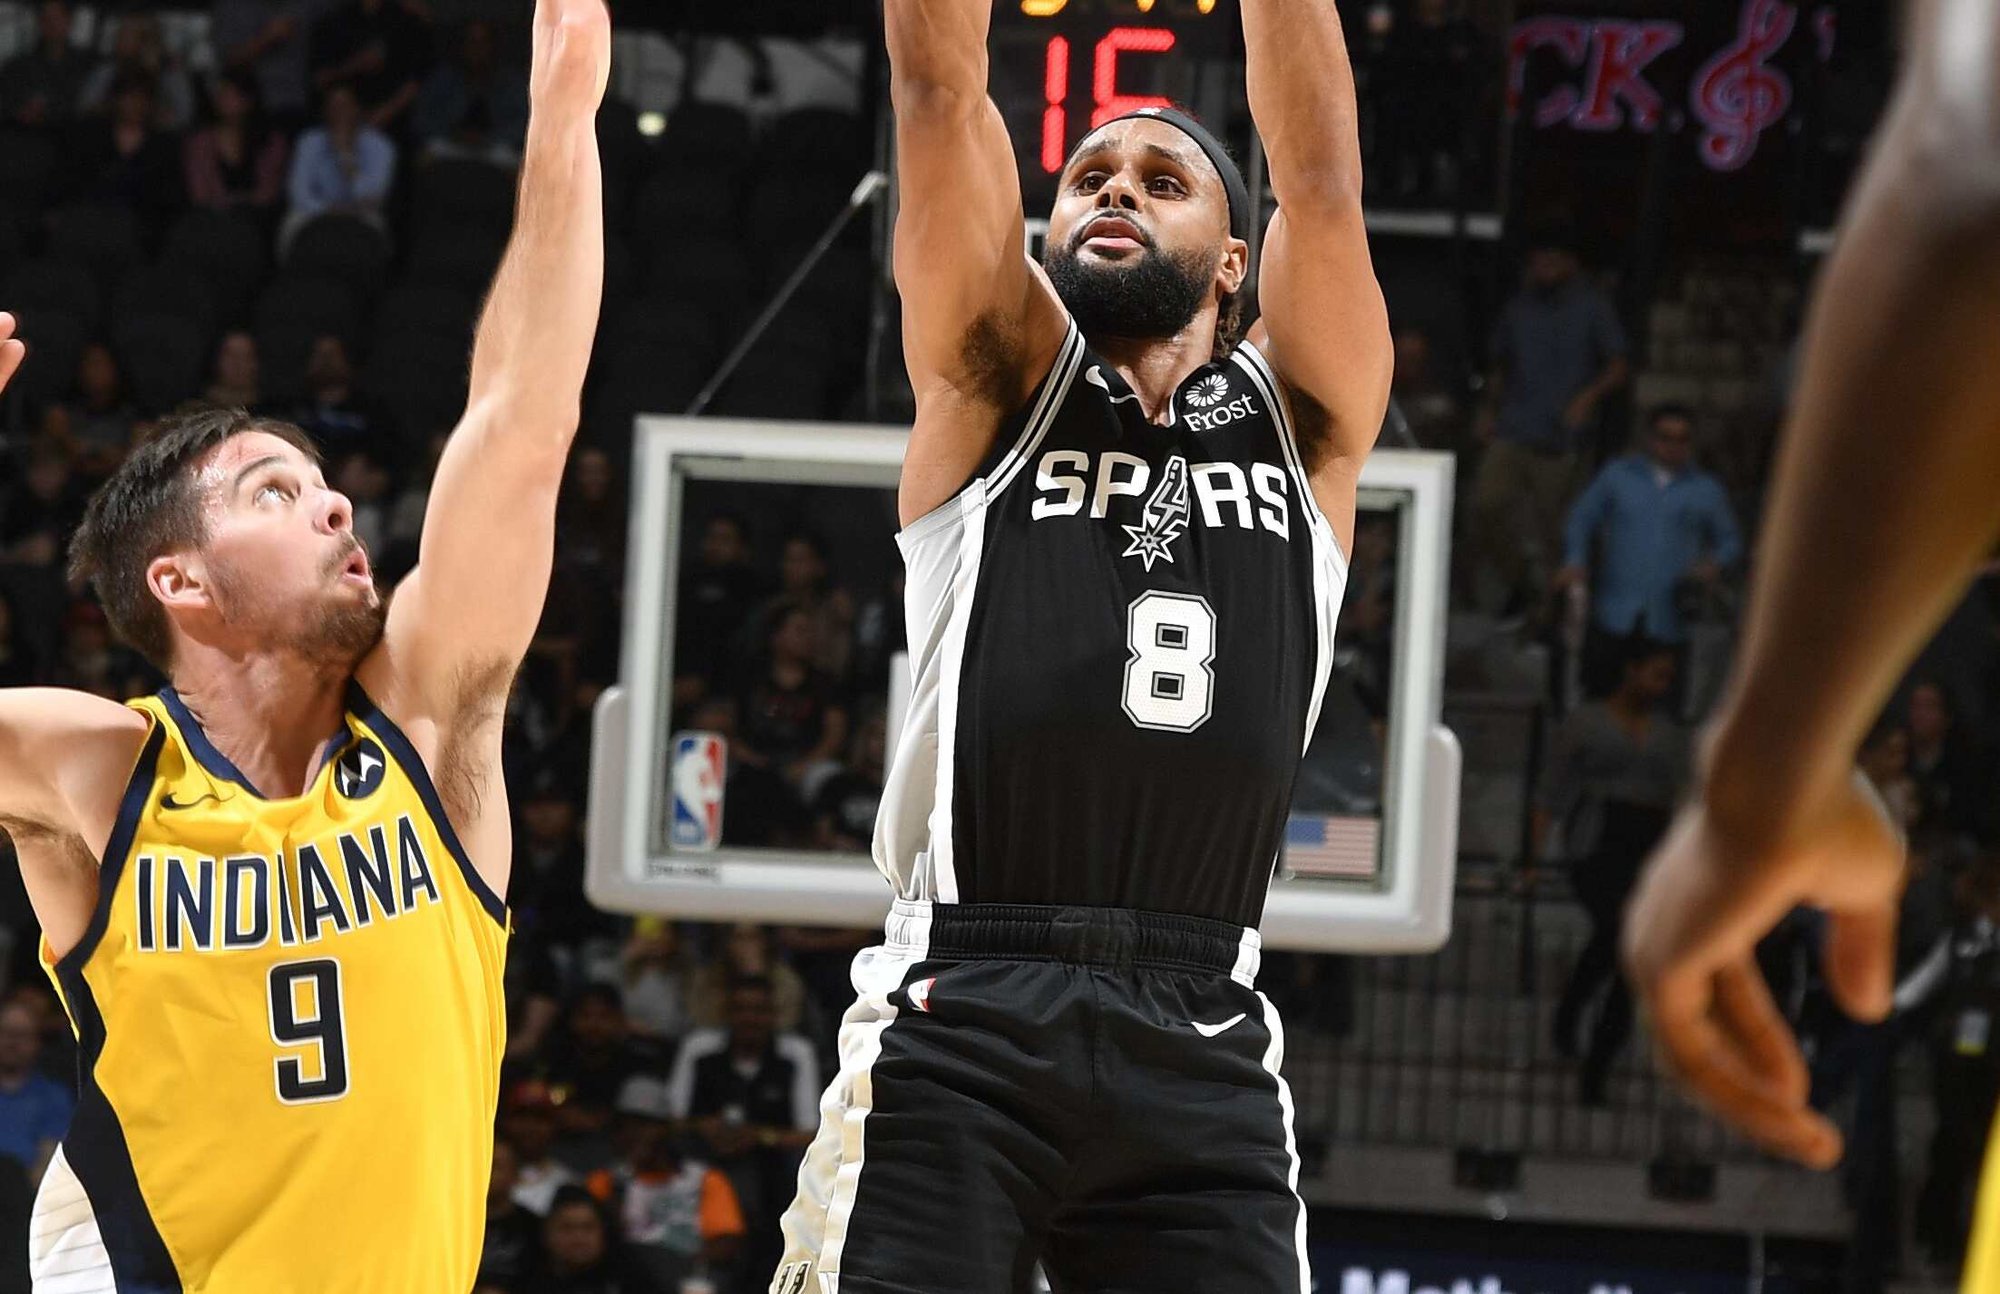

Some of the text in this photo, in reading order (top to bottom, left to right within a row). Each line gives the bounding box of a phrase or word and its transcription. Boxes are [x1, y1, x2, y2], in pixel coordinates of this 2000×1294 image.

[1182, 393, 1259, 432] Frost
[1031, 450, 1290, 572] SPURS
[1121, 589, 1217, 734] 8
[135, 812, 440, 952] INDIANA
[266, 957, 350, 1106] 9
